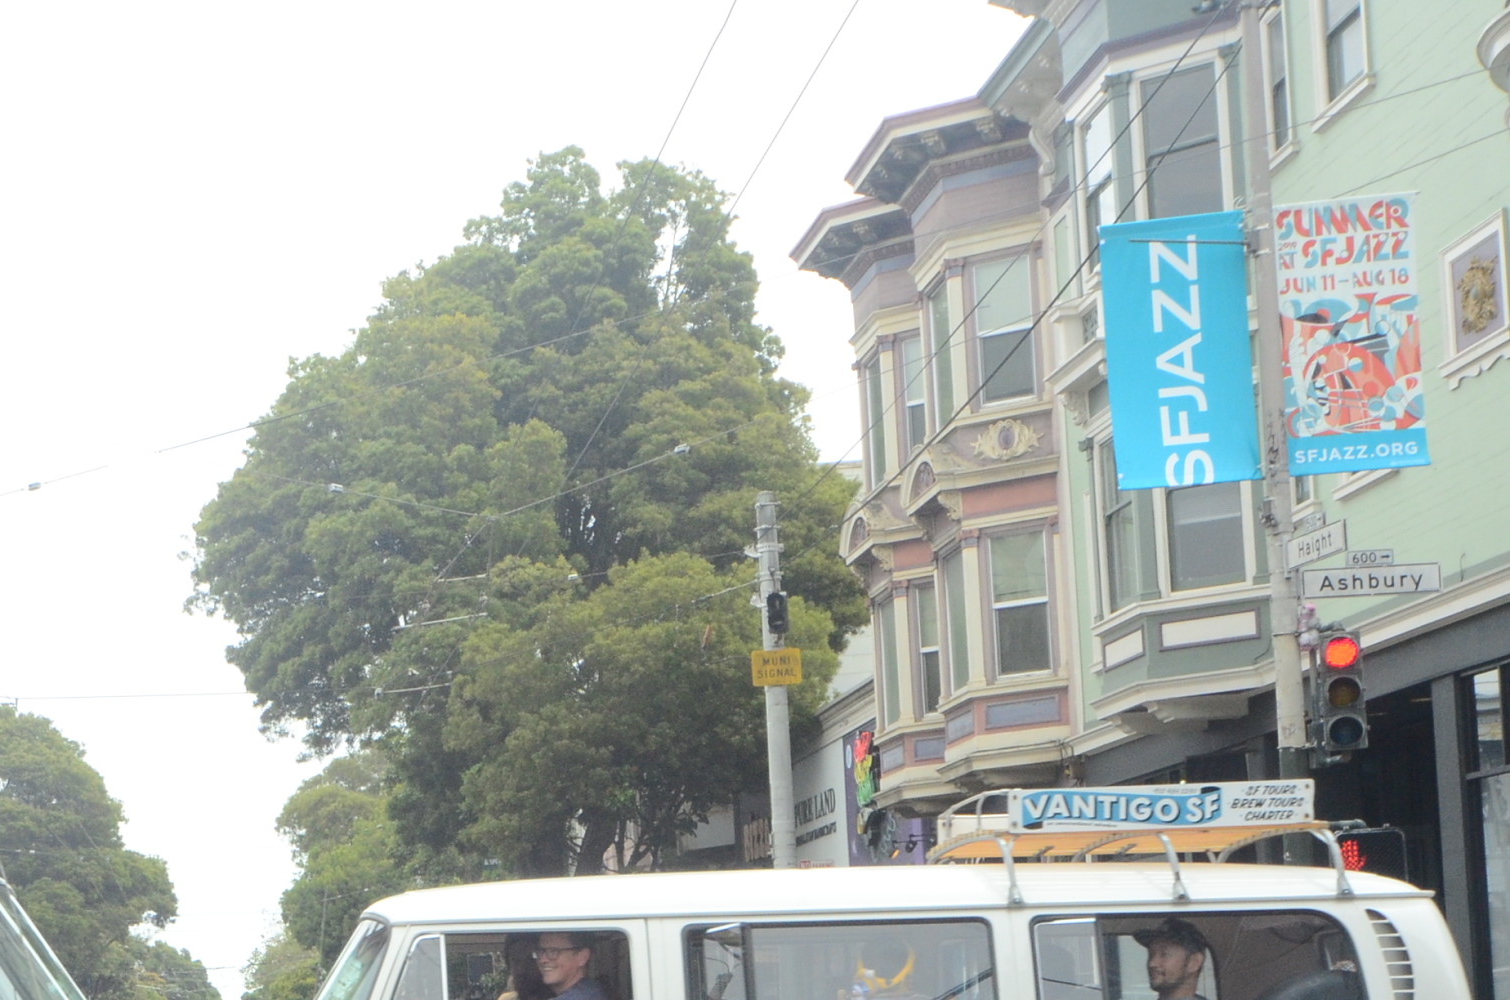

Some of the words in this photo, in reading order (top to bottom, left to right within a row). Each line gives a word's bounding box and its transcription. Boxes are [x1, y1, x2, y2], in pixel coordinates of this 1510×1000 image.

[1276, 198, 1410, 240] SUMMER
[1278, 251, 1298, 270] AT
[1302, 231, 1409, 269] SFJAZZ
[1279, 276, 1316, 295] JUN
[1321, 274, 1335, 291] 11
[1353, 270, 1385, 288] AUG
[1389, 267, 1409, 286] 18
[1148, 234, 1215, 487] SFJAZZ
[1295, 441, 1418, 464] SFJAZZ.ORG
[1298, 530, 1333, 558] Haight
[1352, 552, 1377, 564] 600
[1319, 574, 1423, 592] Ashbury
[757, 667, 796, 679] SIGNAL
[762, 656, 790, 667] MUNI
[1245, 786, 1260, 796] SF
[1262, 784, 1297, 795] TOURS
[814, 788, 836, 820] LAND
[1024, 793, 1180, 823] VANTIGO
[1185, 793, 1220, 823] SF
[1230, 798, 1267, 809] BREW
[1268, 797, 1305, 808] TOURS
[1244, 810, 1294, 821] CHARTER
